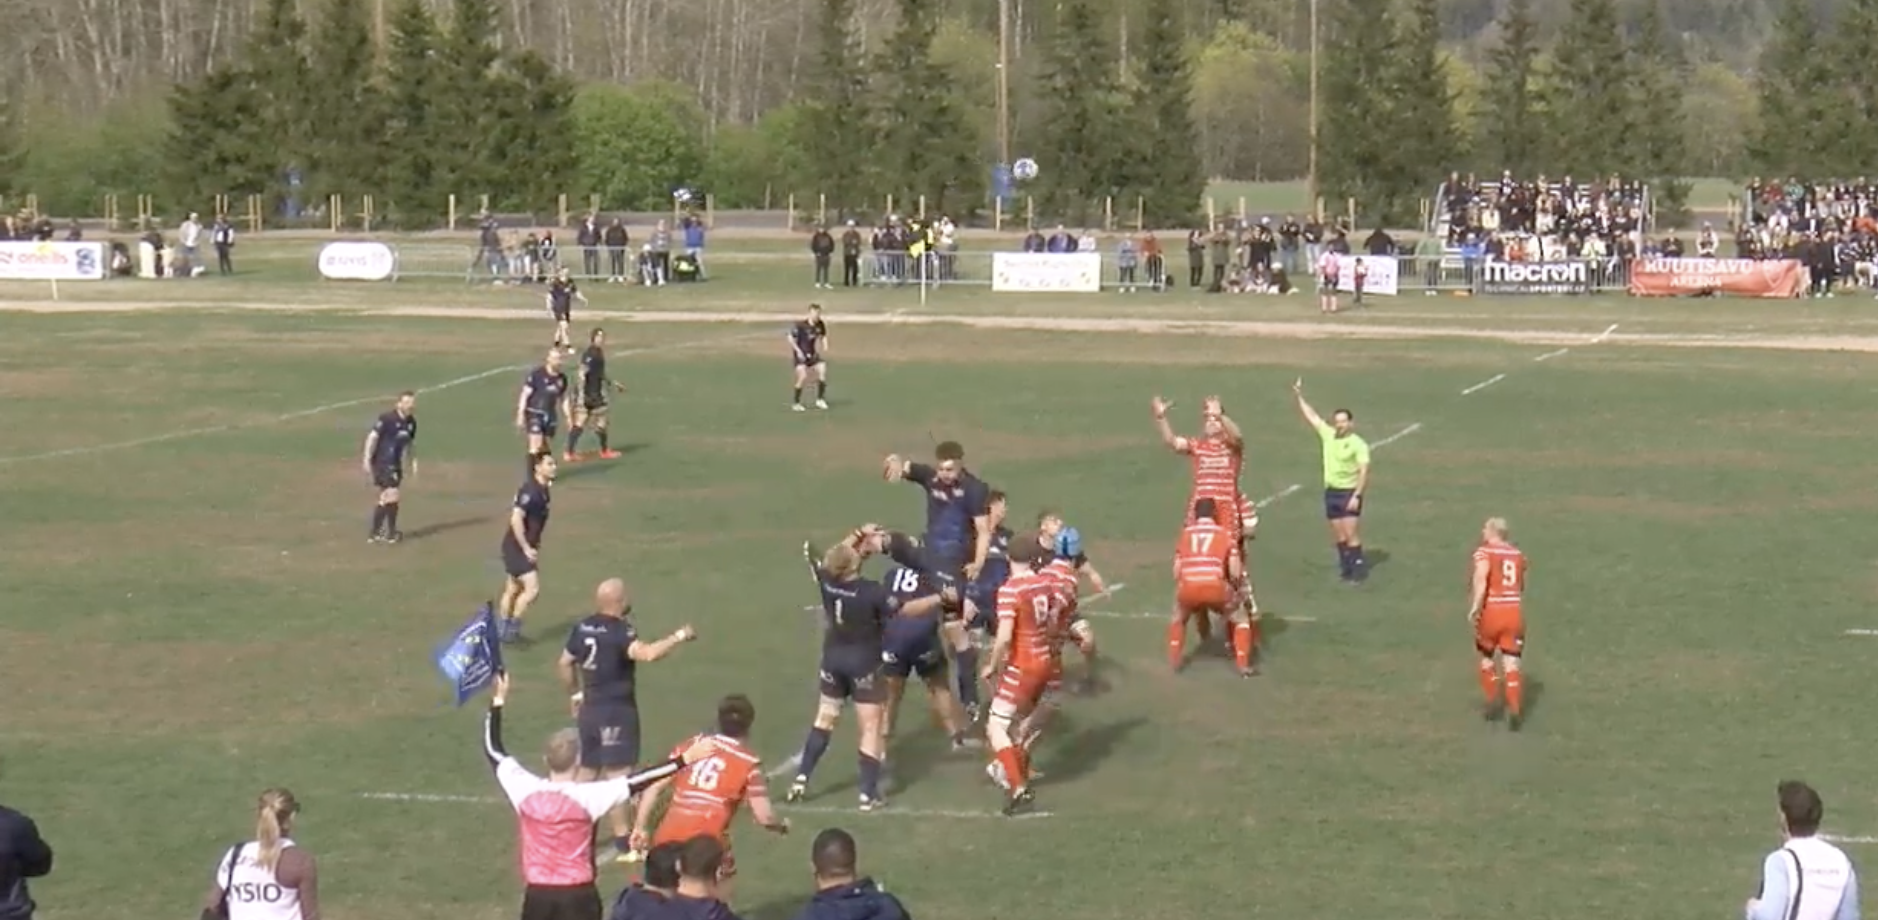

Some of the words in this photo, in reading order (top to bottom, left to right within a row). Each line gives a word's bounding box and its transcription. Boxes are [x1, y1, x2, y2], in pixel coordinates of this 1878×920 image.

[1484, 254, 1586, 282] macron
[1191, 532, 1214, 554] 17
[892, 567, 919, 592] 18
[1502, 559, 1516, 586] 9
[834, 598, 843, 625] 1
[582, 637, 597, 670] 2
[687, 757, 726, 791] 16
[230, 882, 282, 903] YSIO
